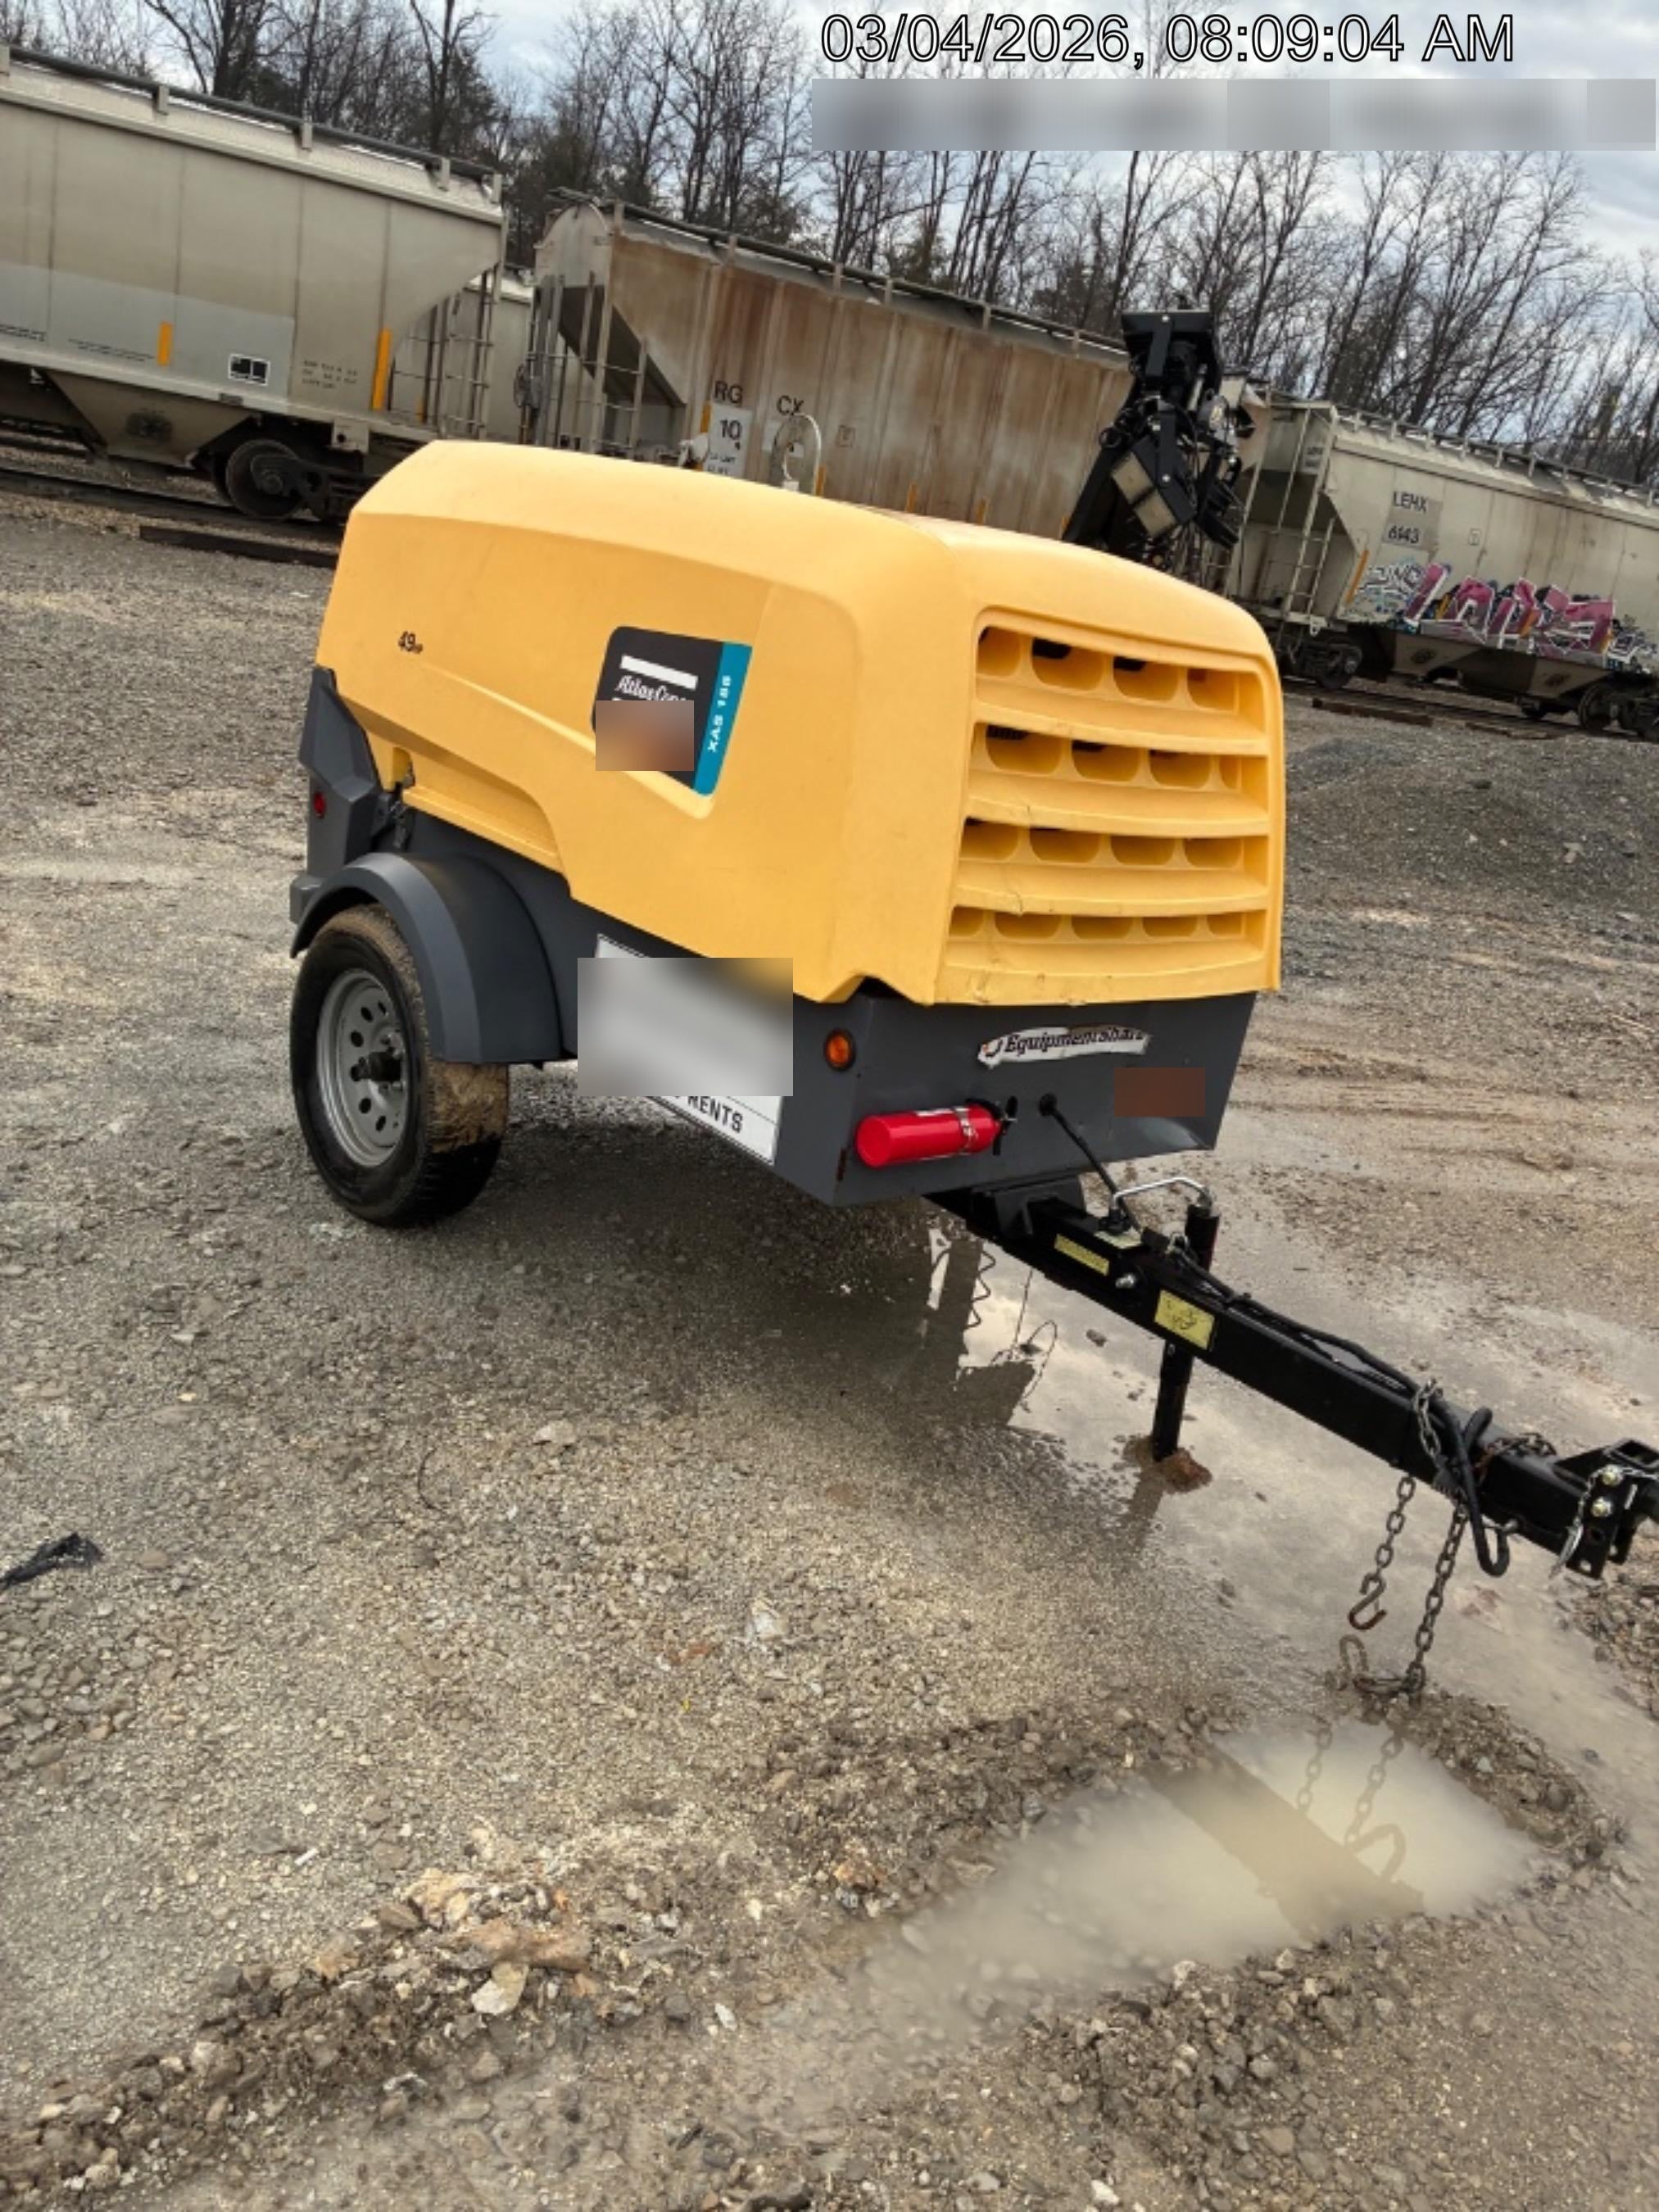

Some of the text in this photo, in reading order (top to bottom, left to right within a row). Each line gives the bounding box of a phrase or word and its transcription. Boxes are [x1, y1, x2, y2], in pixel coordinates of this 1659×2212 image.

[714, 380, 805, 416] RG CX
[707, 714, 724, 753] XAS
